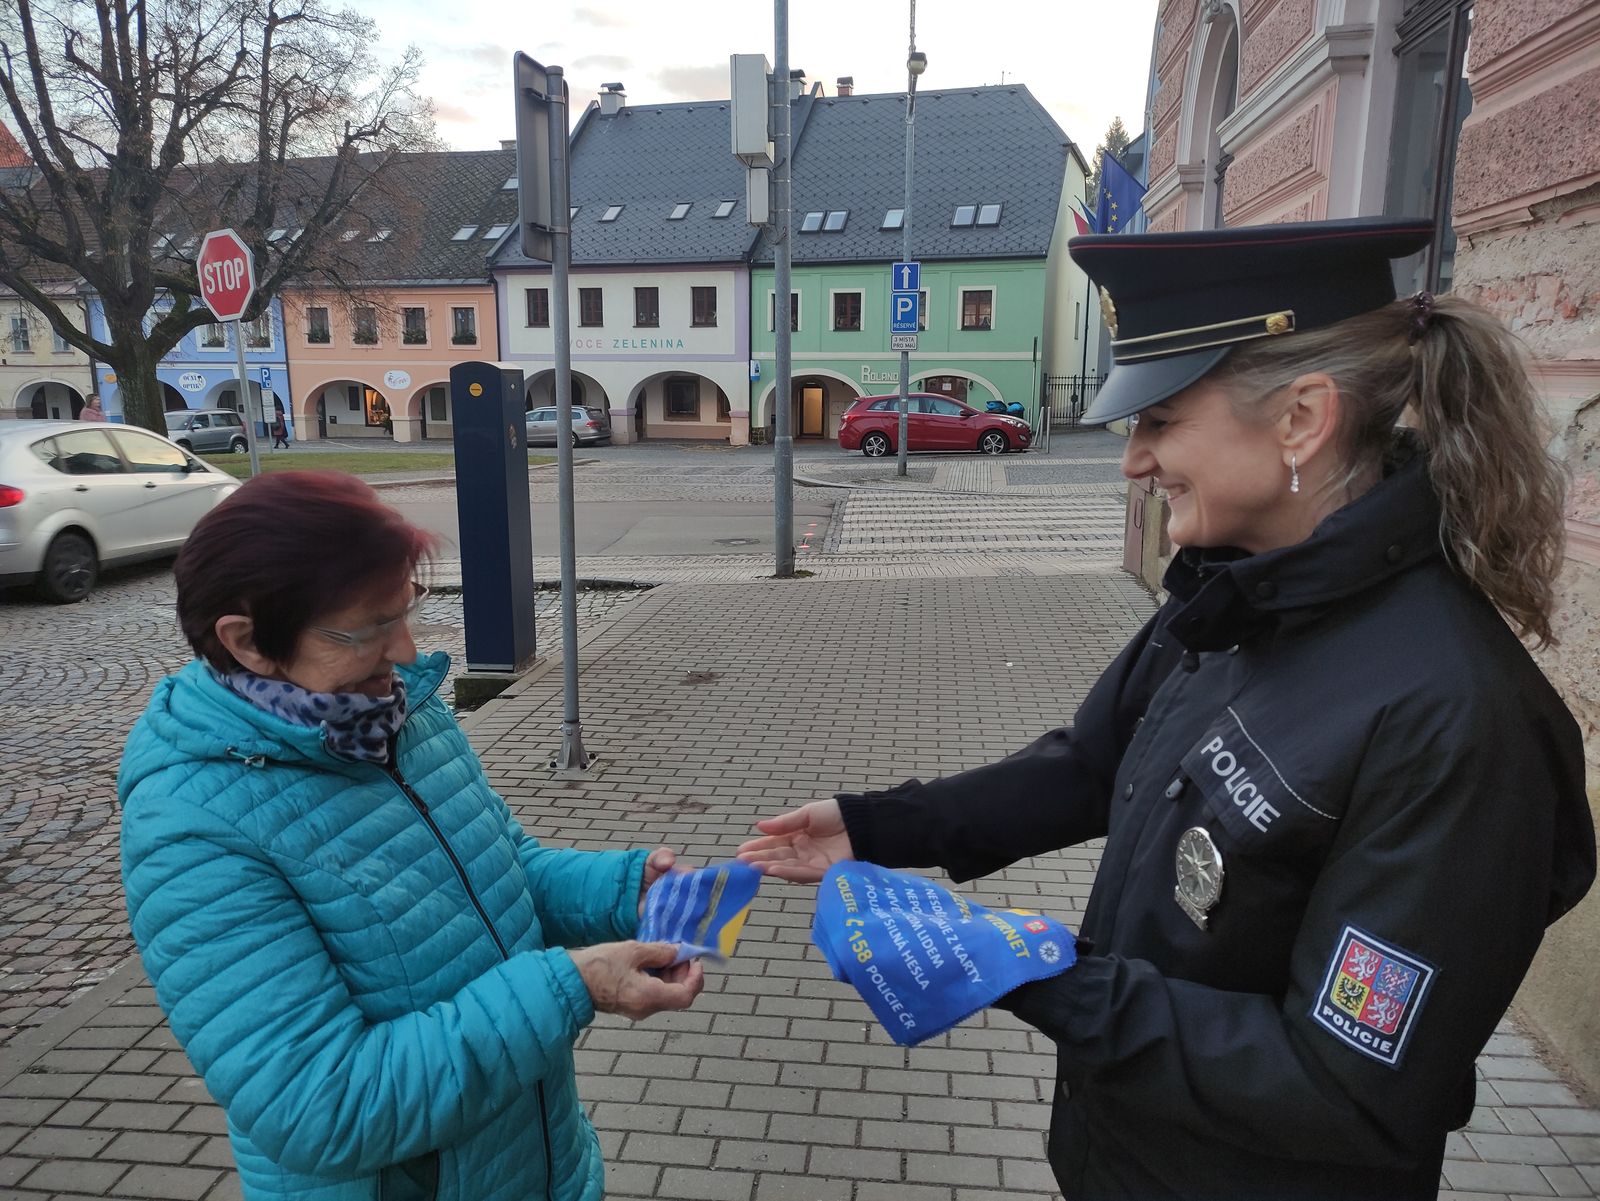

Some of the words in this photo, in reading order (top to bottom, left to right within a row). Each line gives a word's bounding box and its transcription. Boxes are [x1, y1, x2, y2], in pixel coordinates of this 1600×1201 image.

[204, 257, 244, 294] STOP
[897, 297, 913, 321] P
[569, 339, 603, 349] OCE
[612, 339, 684, 349] ZELENINA
[262, 369, 269, 382] P
[1200, 735, 1281, 833] POLICIE
[835, 874, 859, 914] VOLEJTE
[848, 930, 873, 964] 158
[865, 965, 904, 1013] POLICIE
[898, 1012, 916, 1029] ČR
[883, 920, 910, 952] SILNÁ
[901, 949, 930, 990] HESLA
[916, 929, 945, 969] LIDEM
[946, 932, 959, 945] Z
[983, 913, 1031, 959] NTERNET
[952, 943, 983, 984] KARTY
[1322, 1005, 1393, 1053] POLICIE
